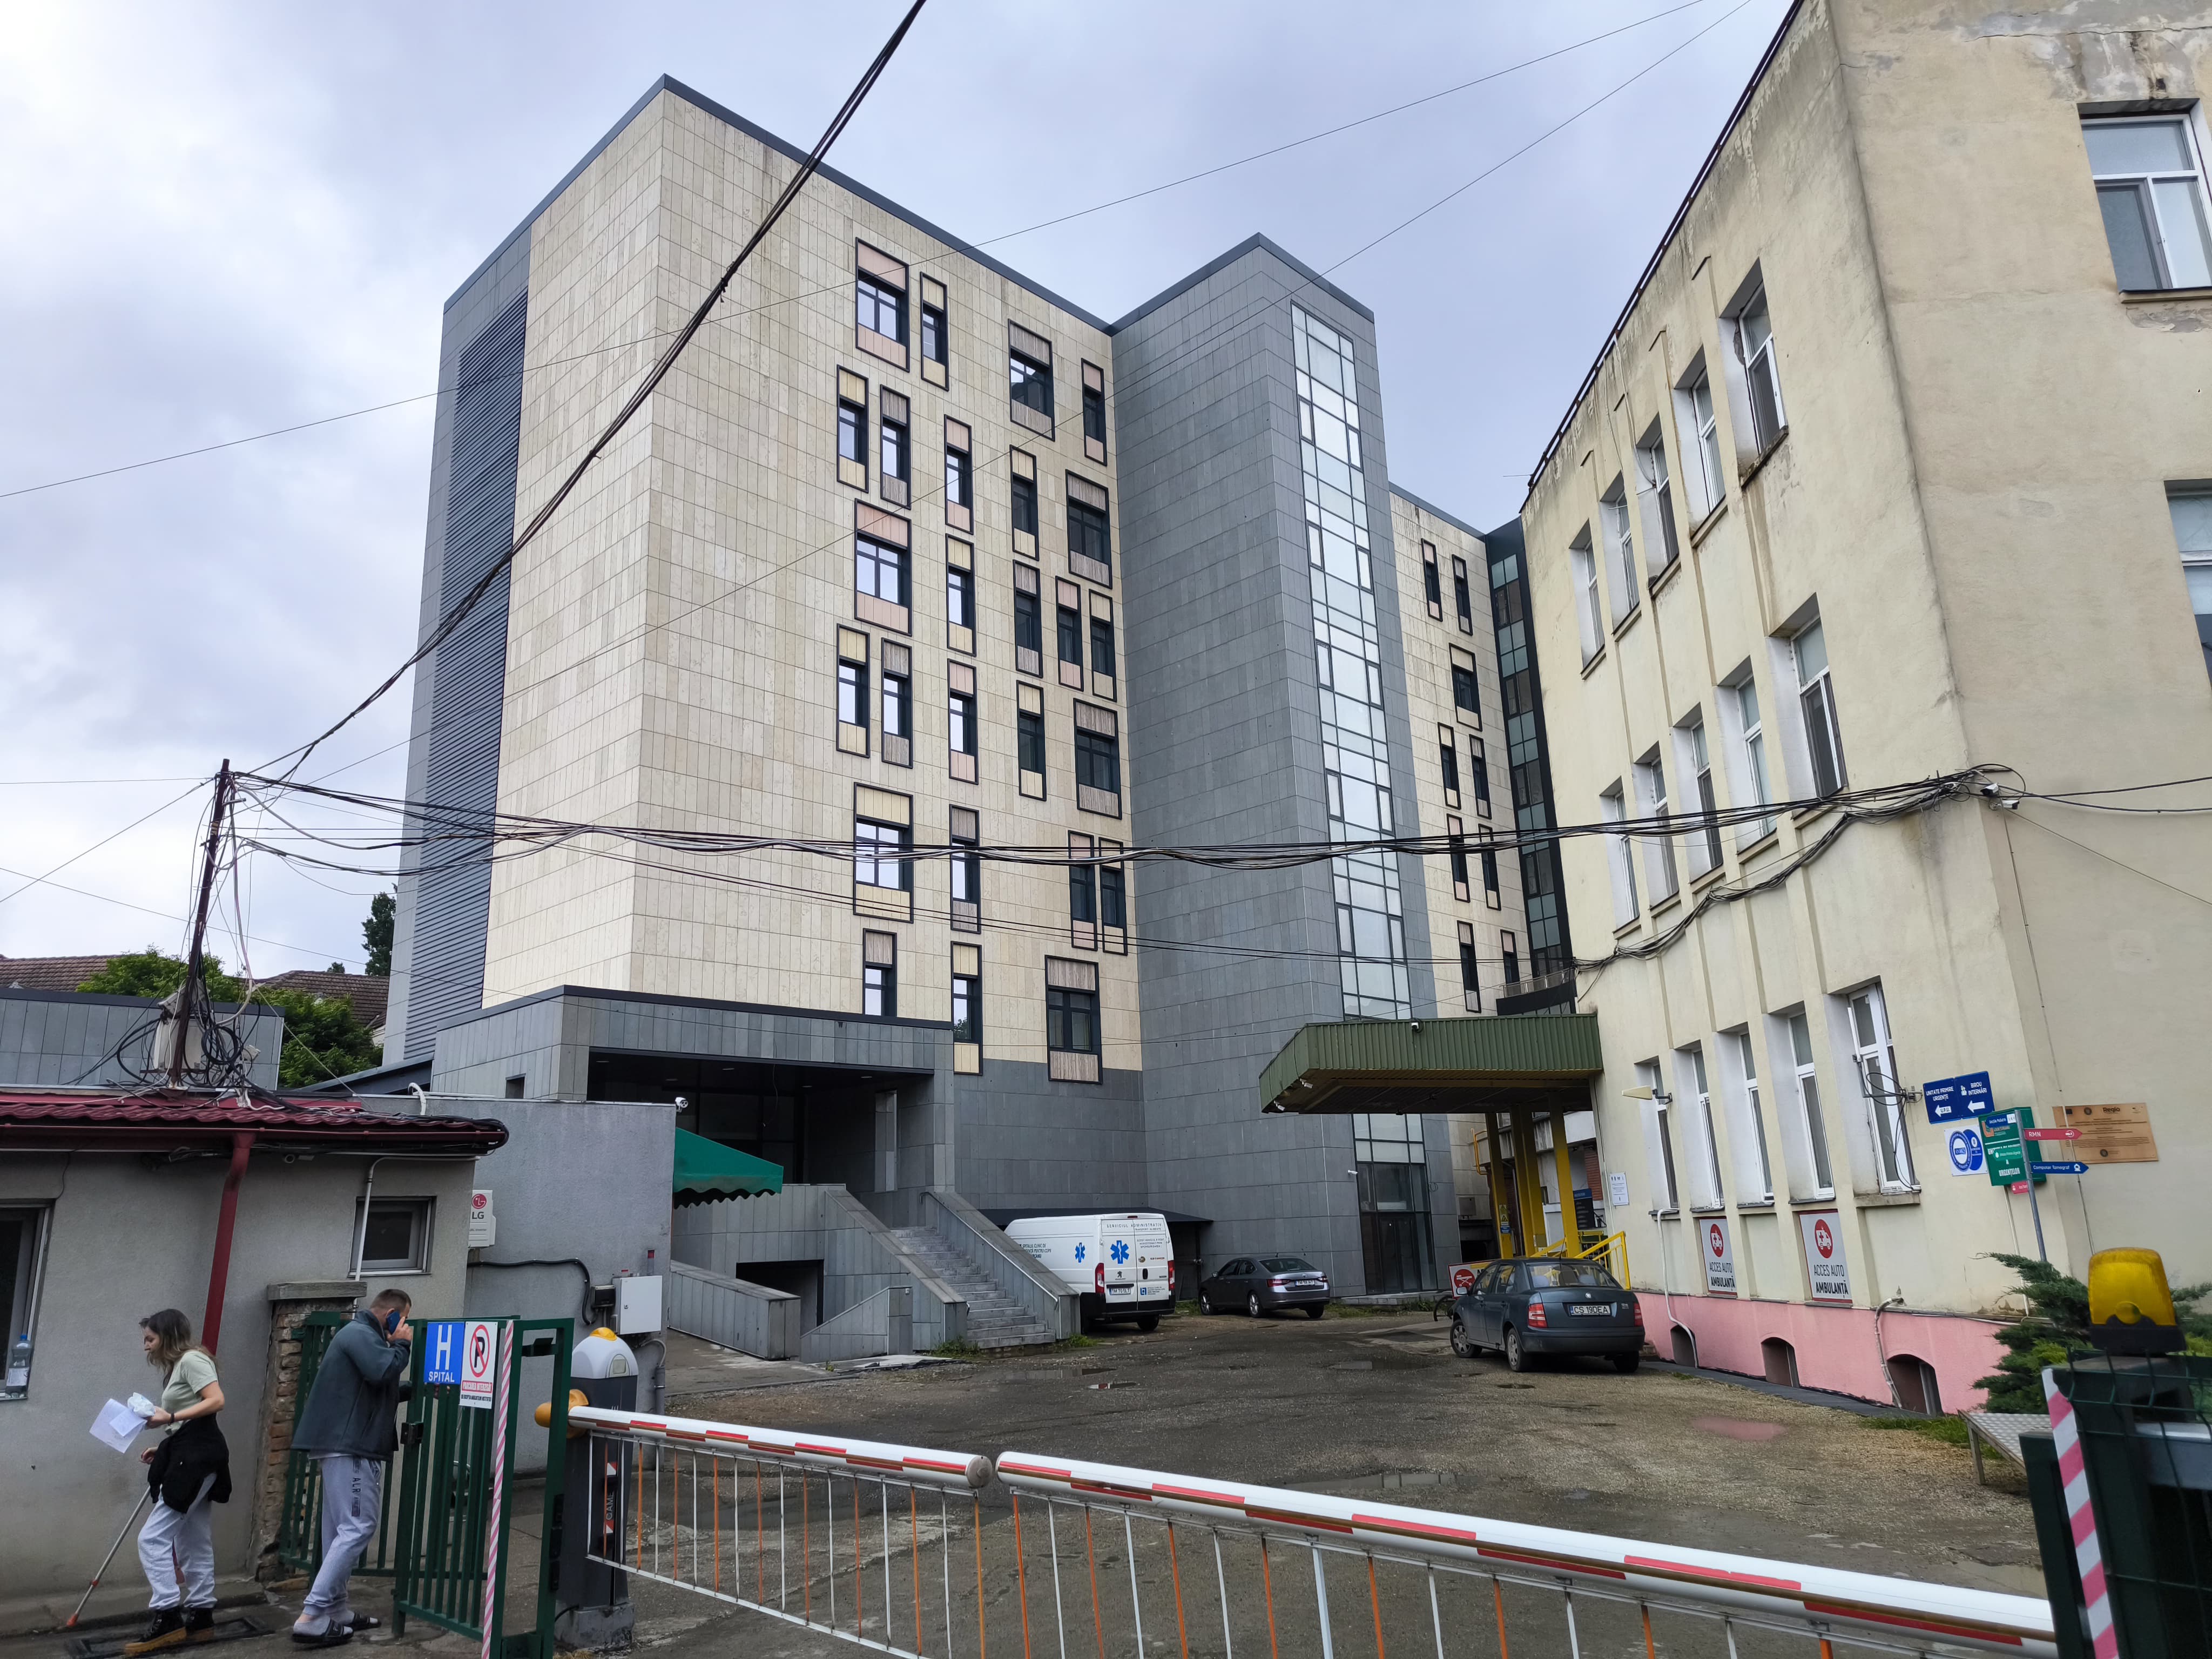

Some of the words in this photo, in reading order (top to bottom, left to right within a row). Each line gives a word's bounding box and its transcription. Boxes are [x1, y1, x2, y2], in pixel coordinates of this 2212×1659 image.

[472, 1211, 484, 1219] LG
[1709, 1262, 1722, 1272] ACCES
[1722, 1263, 1732, 1273] AUTO
[1813, 1264, 1830, 1276] ACCES
[1831, 1264, 1845, 1277] AUTO
[1711, 1276, 1736, 1291] AMBULANȚĂ
[1816, 1280, 1849, 1298] AMBULANȚĂ
[435, 1325, 453, 1370] H
[428, 1371, 455, 1382] SPITAL
[352, 1477, 361, 1493] ALR
